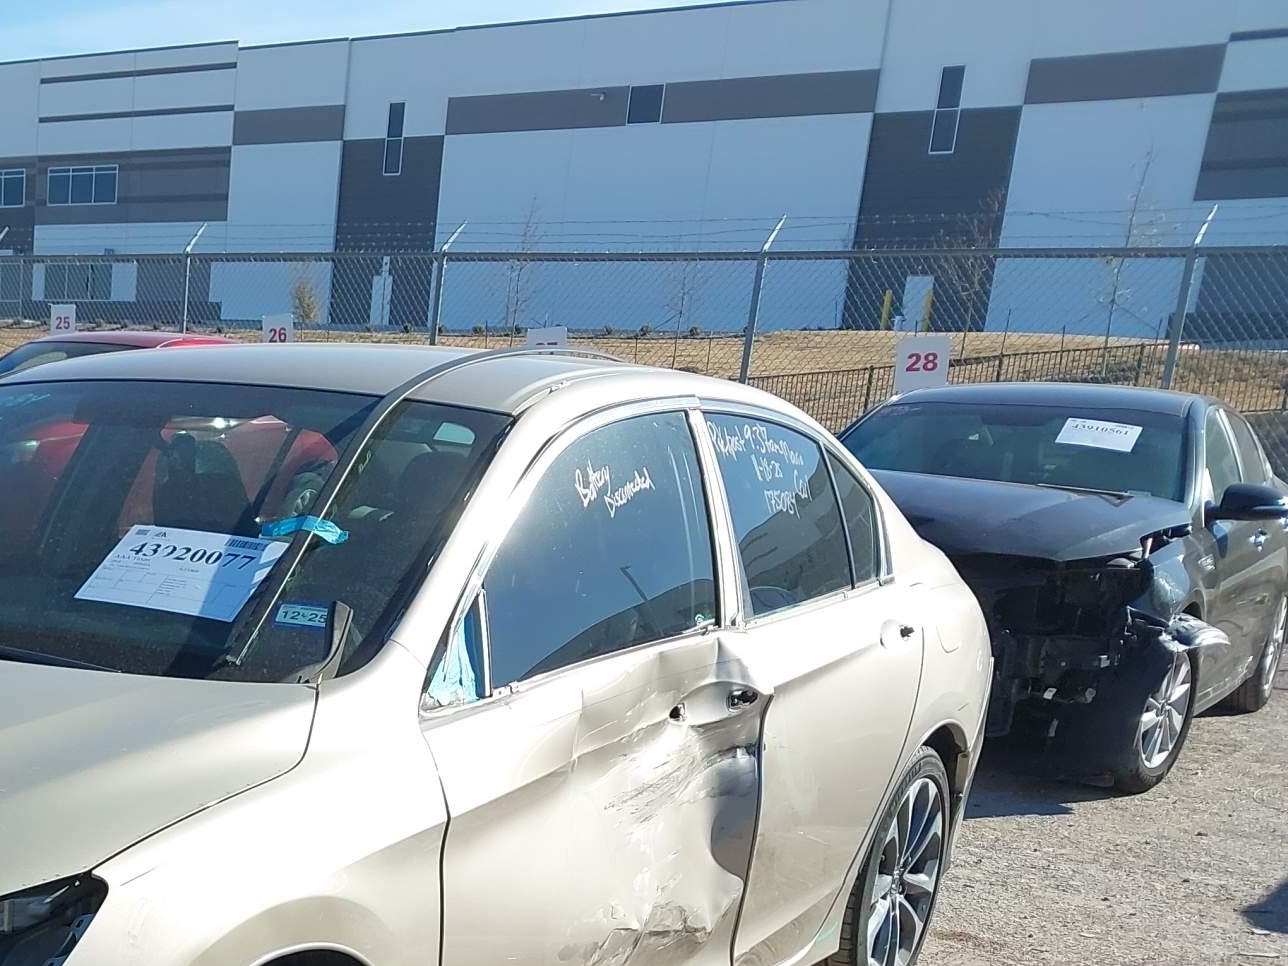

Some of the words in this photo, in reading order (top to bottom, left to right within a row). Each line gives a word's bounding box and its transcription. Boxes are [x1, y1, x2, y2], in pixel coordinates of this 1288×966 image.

[55, 316, 70, 330] 25
[269, 327, 287, 343] 26
[905, 352, 938, 372] 28
[129, 541, 257, 571] 43920077
[282, 610, 301, 621] 12
